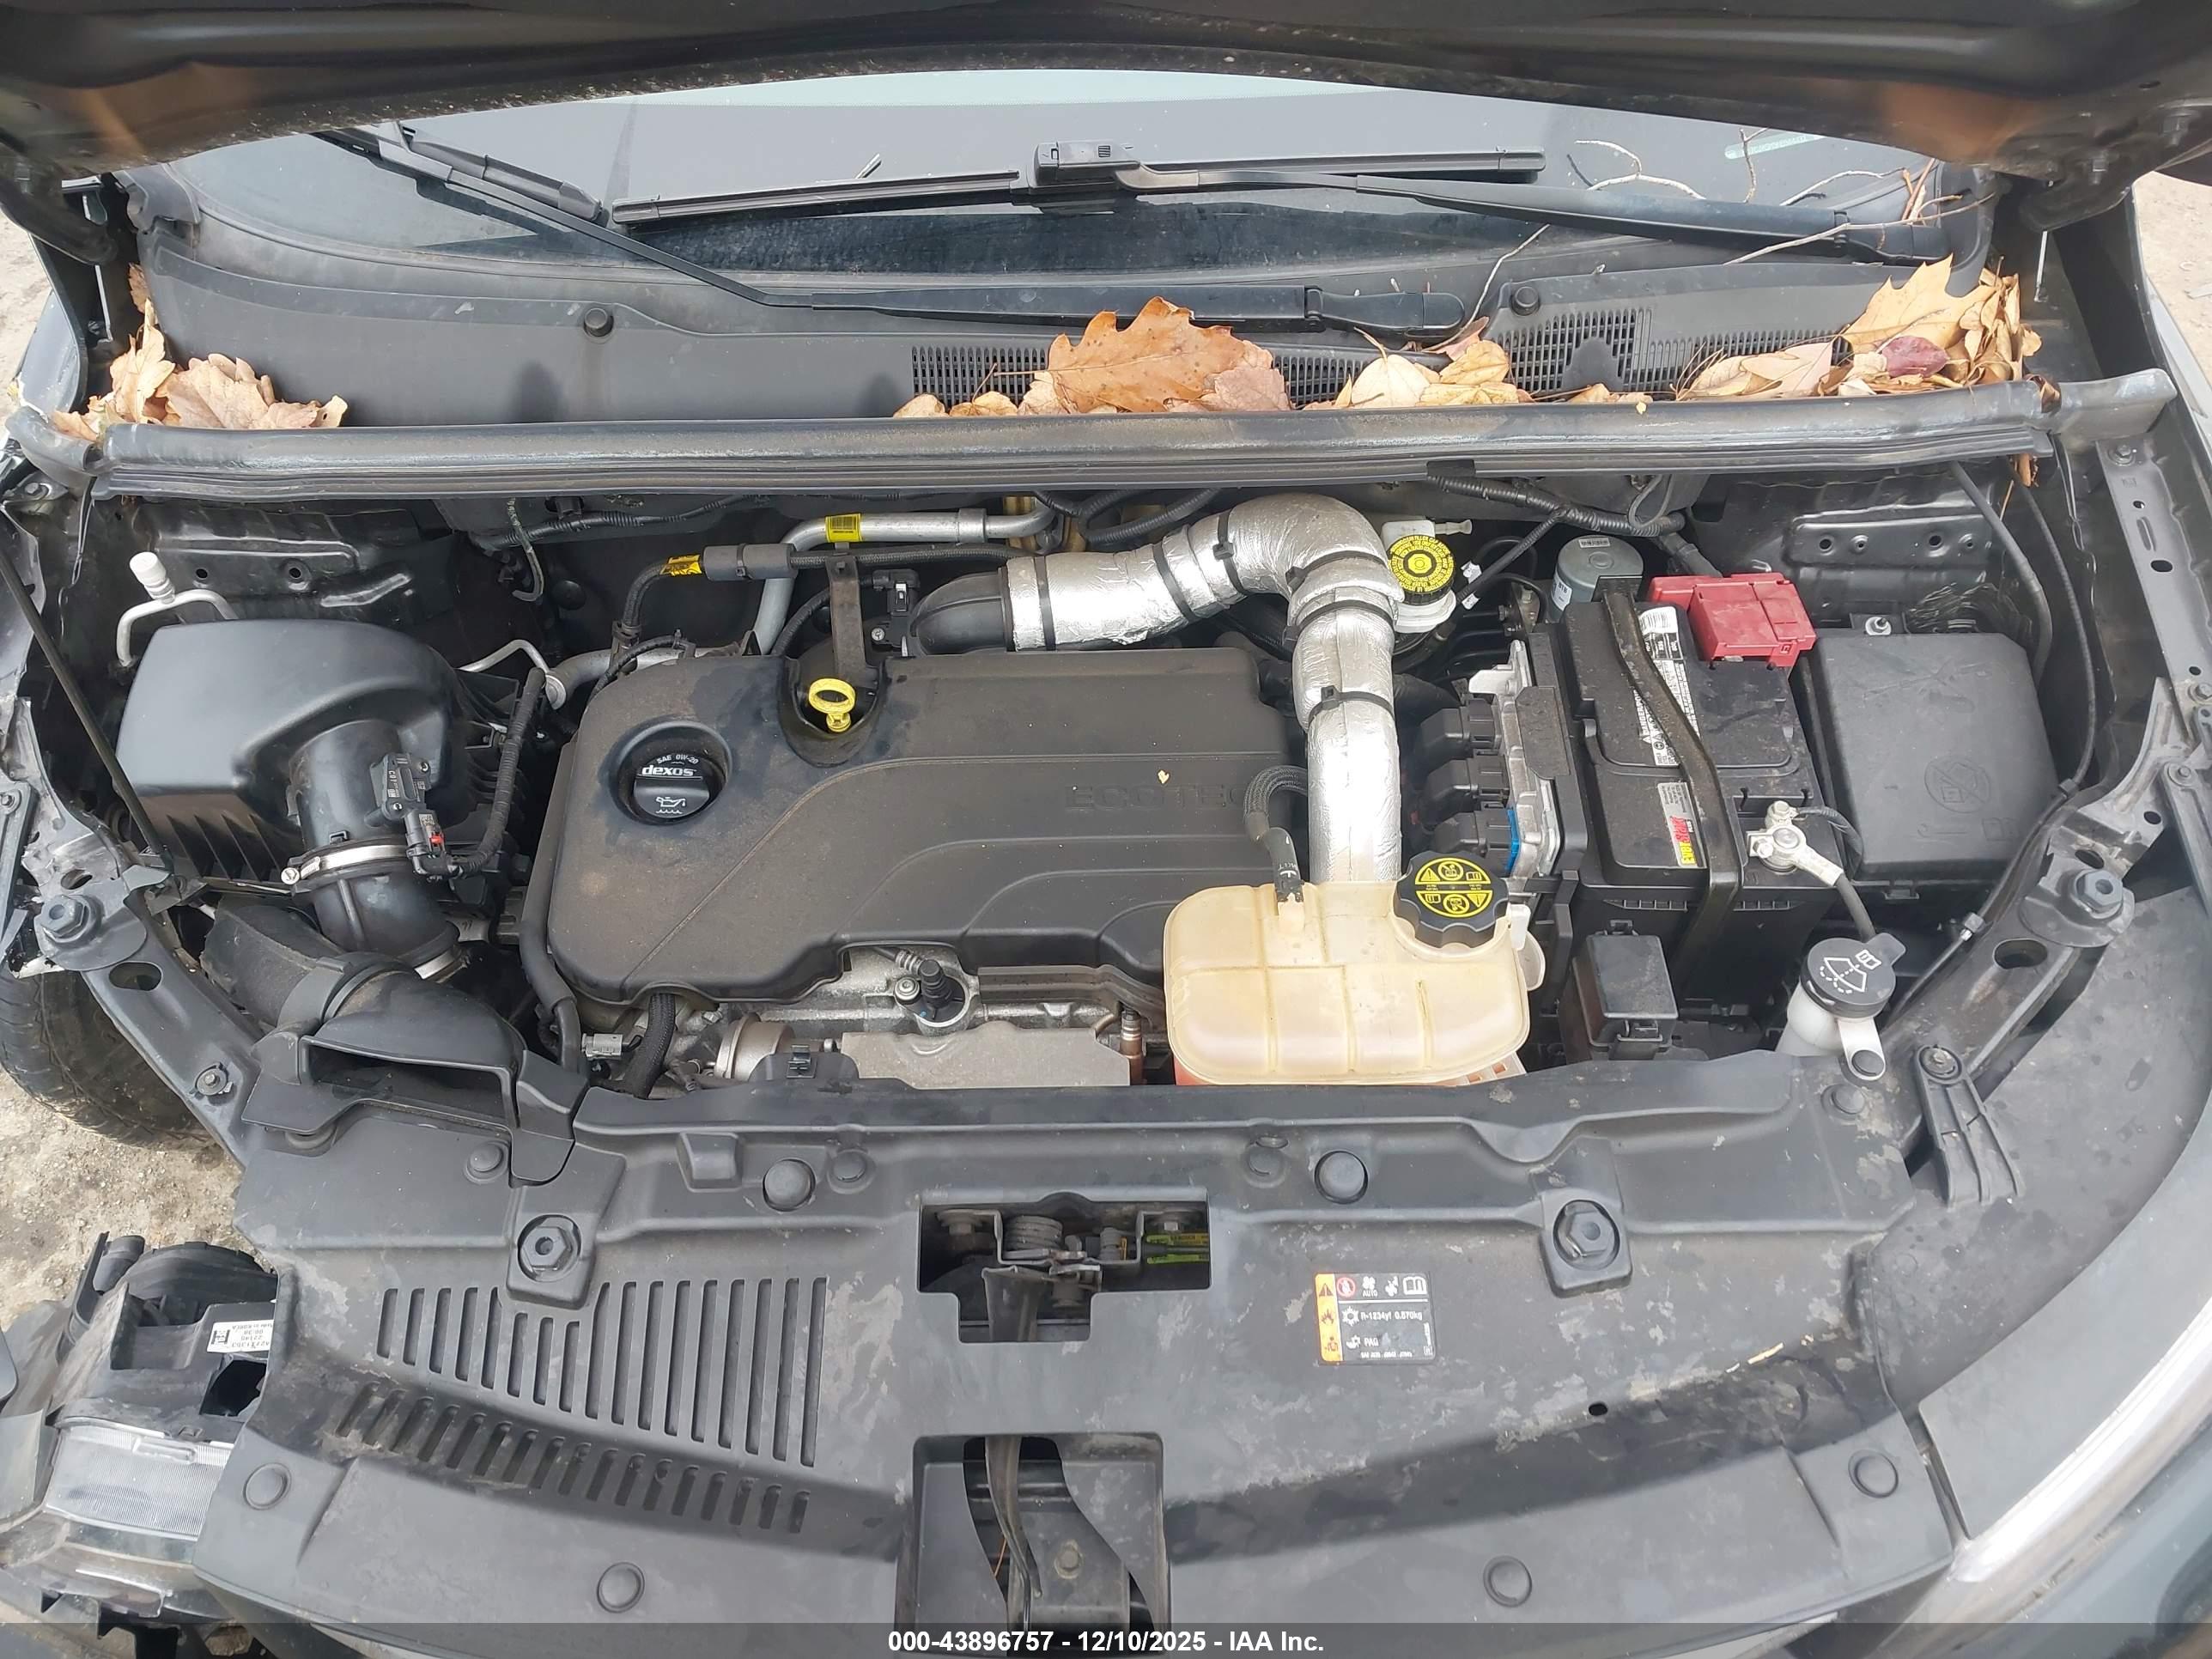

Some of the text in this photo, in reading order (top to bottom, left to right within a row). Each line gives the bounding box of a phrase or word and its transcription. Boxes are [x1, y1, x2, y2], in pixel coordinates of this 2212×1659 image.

[656, 754, 699, 764] SAE 0W-20
[641, 764, 694, 777] dexos
[1364, 1337, 1379, 1346] PAG
